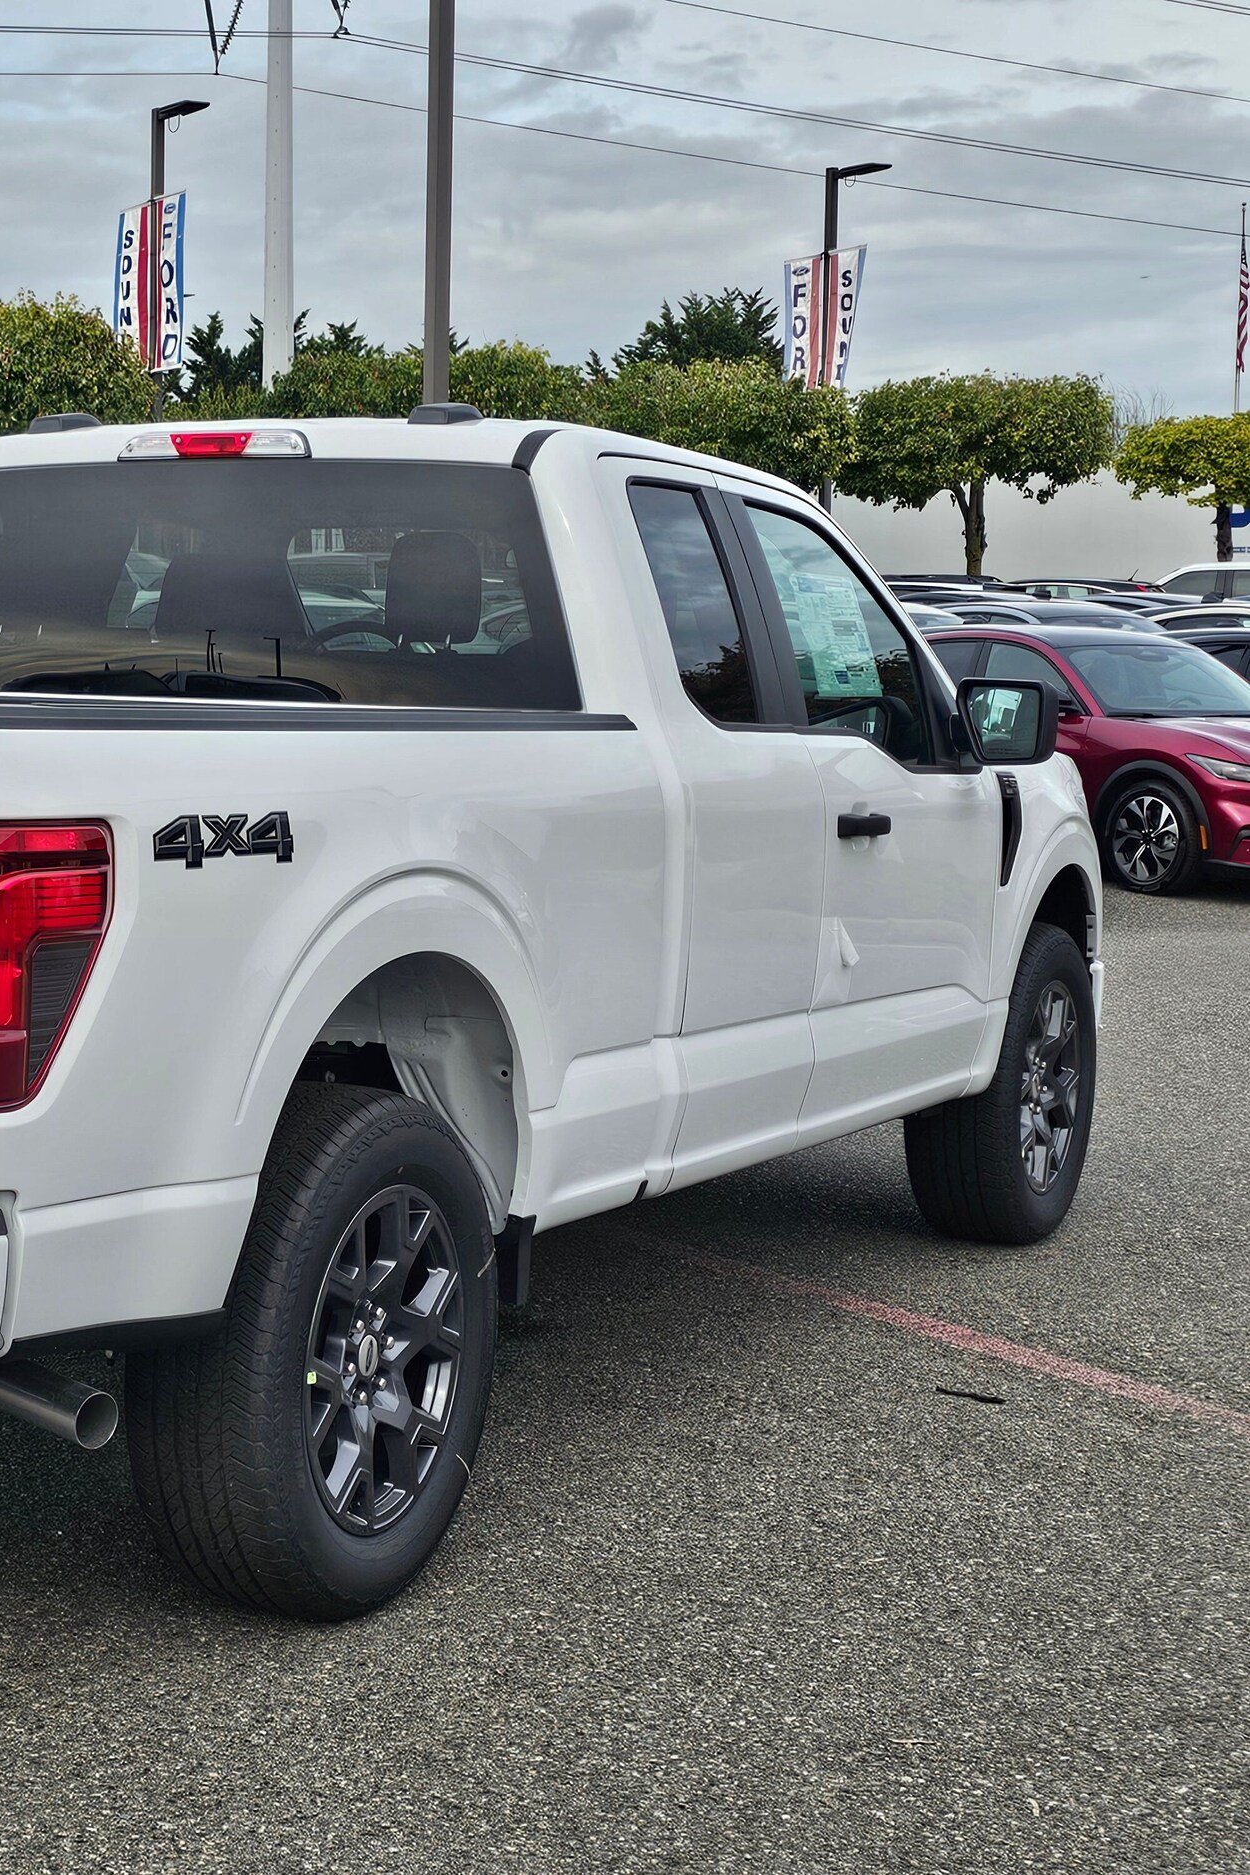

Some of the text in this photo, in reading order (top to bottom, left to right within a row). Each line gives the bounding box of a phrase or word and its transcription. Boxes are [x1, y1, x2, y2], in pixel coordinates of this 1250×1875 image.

[118, 229, 135, 328] SOUN
[160, 222, 178, 361] FORD
[792, 282, 807, 372] FOR
